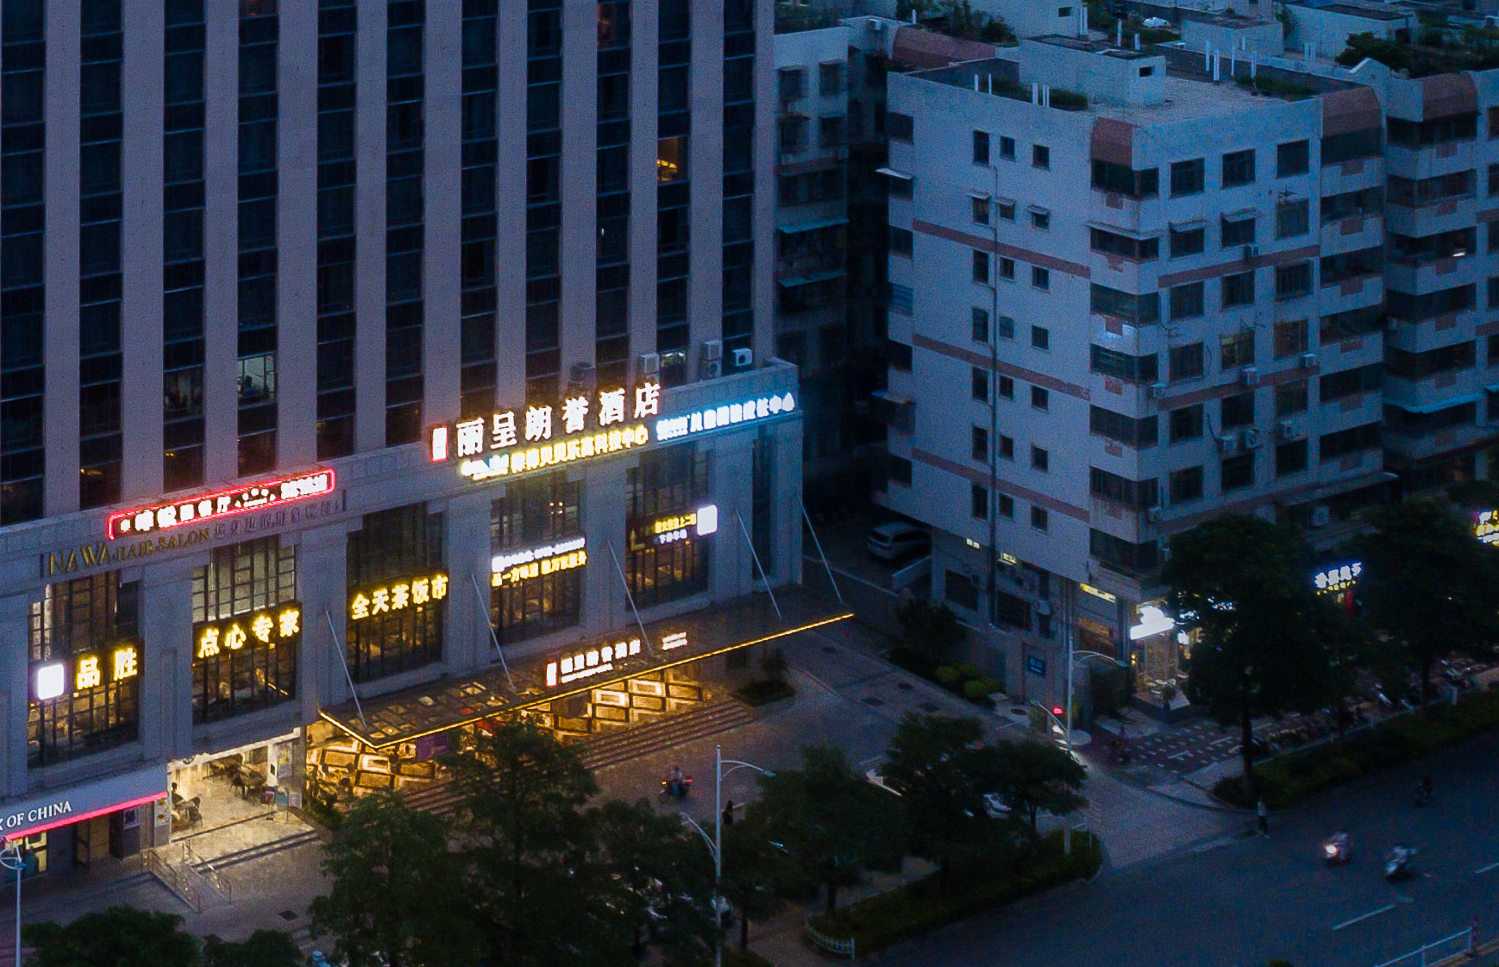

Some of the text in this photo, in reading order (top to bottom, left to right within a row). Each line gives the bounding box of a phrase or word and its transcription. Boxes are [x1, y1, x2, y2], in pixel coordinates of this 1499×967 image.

[454, 381, 662, 458] 丽呈朗誉酒店
[49, 540, 113, 576] NAWA
[157, 527, 211, 550] SALON
[351, 573, 450, 621] 全天茶饭市
[75, 608, 303, 690] 品胜 点心专家
[5, 811, 25, 829] OF
[27, 800, 73, 823] CHINA
